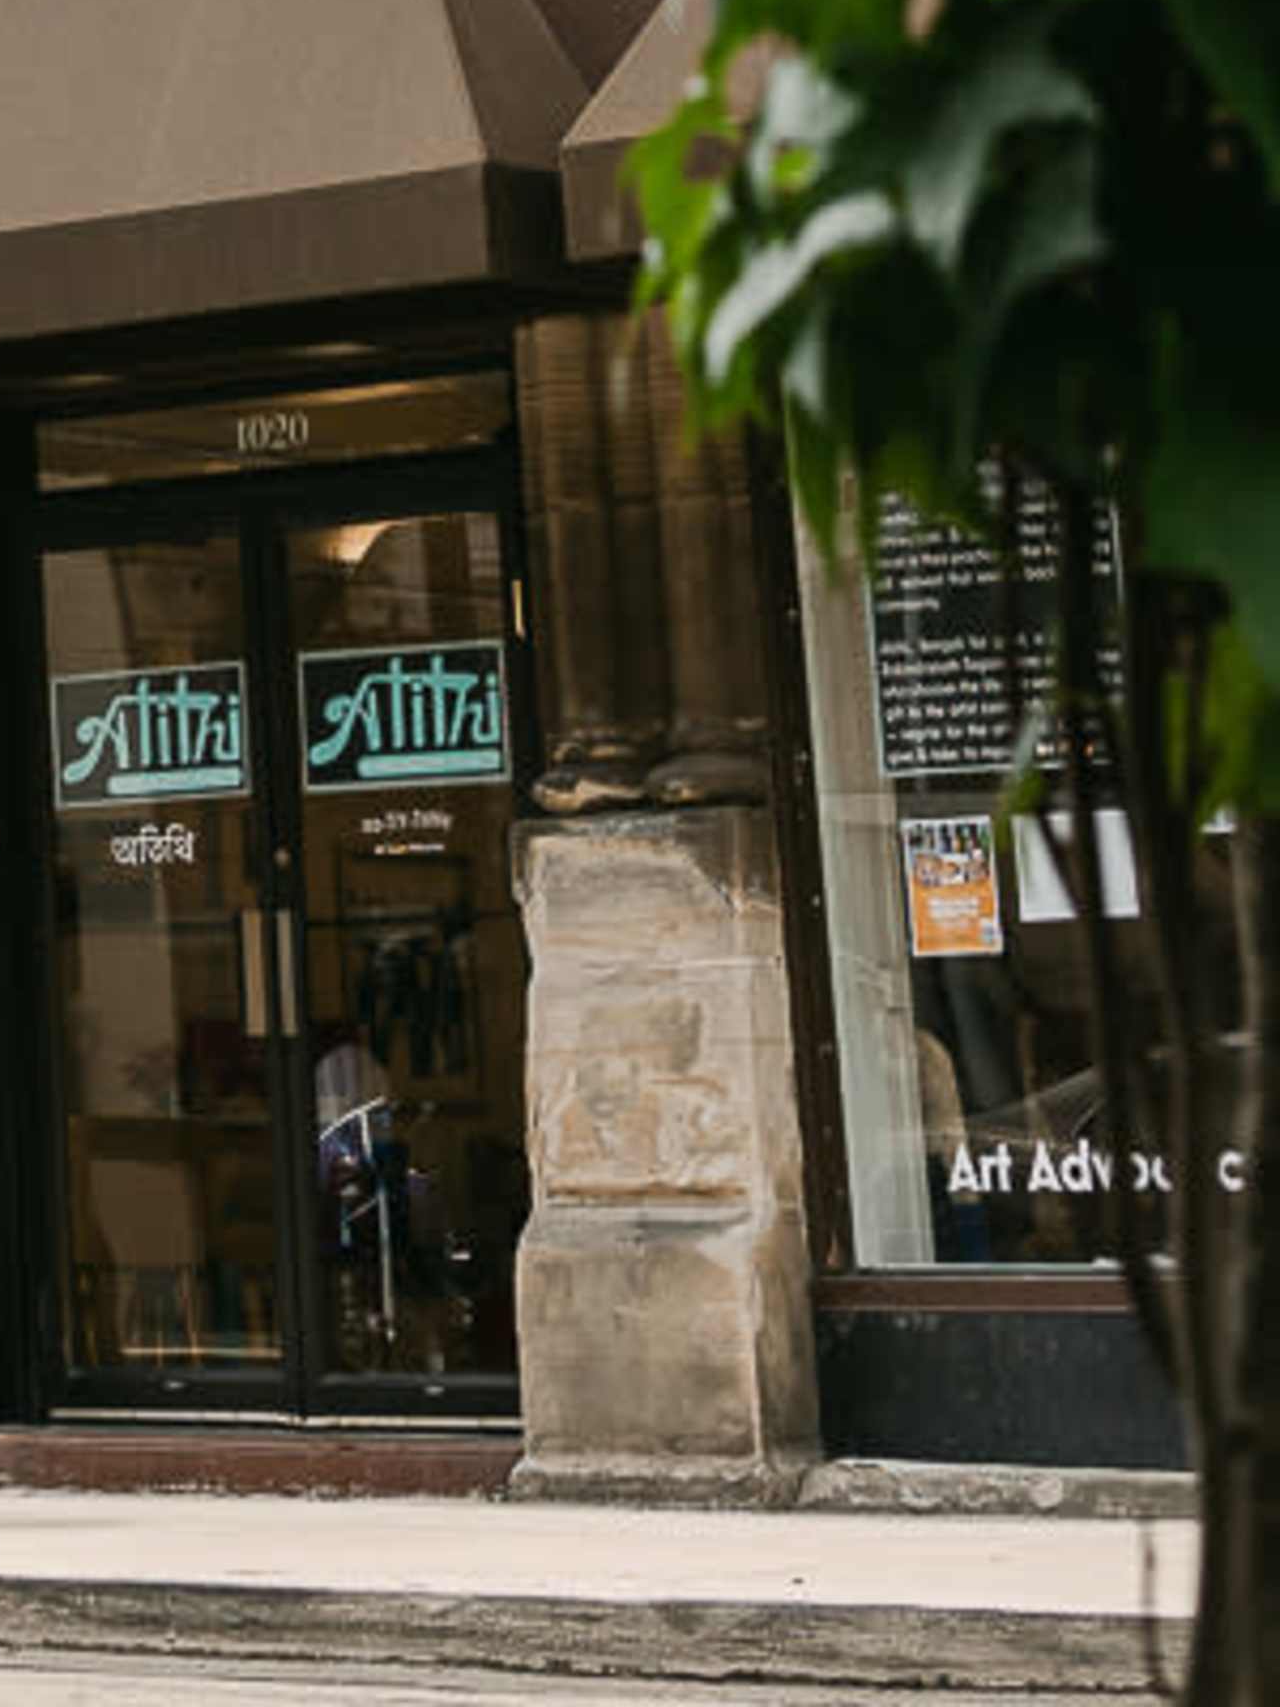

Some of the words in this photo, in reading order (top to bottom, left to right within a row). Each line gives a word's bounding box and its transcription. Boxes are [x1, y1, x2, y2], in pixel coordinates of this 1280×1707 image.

[63, 673, 241, 785] Atithi
[309, 653, 502, 767] Atithi
[948, 1140, 1013, 1192] Art
